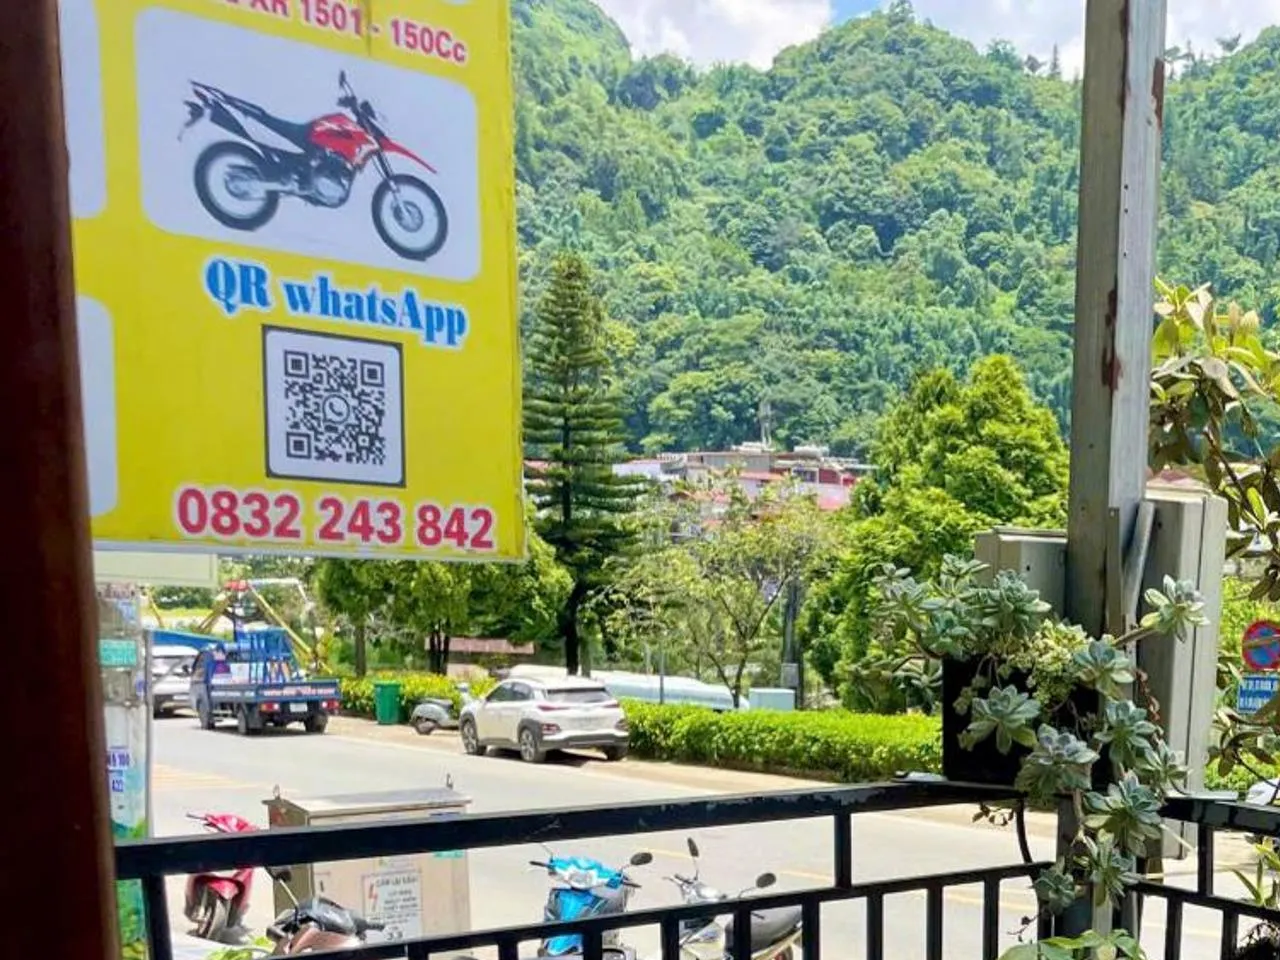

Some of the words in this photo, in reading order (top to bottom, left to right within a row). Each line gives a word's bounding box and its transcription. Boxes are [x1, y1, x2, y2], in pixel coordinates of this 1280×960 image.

[391, 18, 466, 62] 150Cc
[206, 259, 270, 314] QR
[283, 276, 467, 346] whatsApp
[178, 488, 301, 538] 0832
[319, 497, 402, 544] 243
[417, 504, 493, 549] 842
